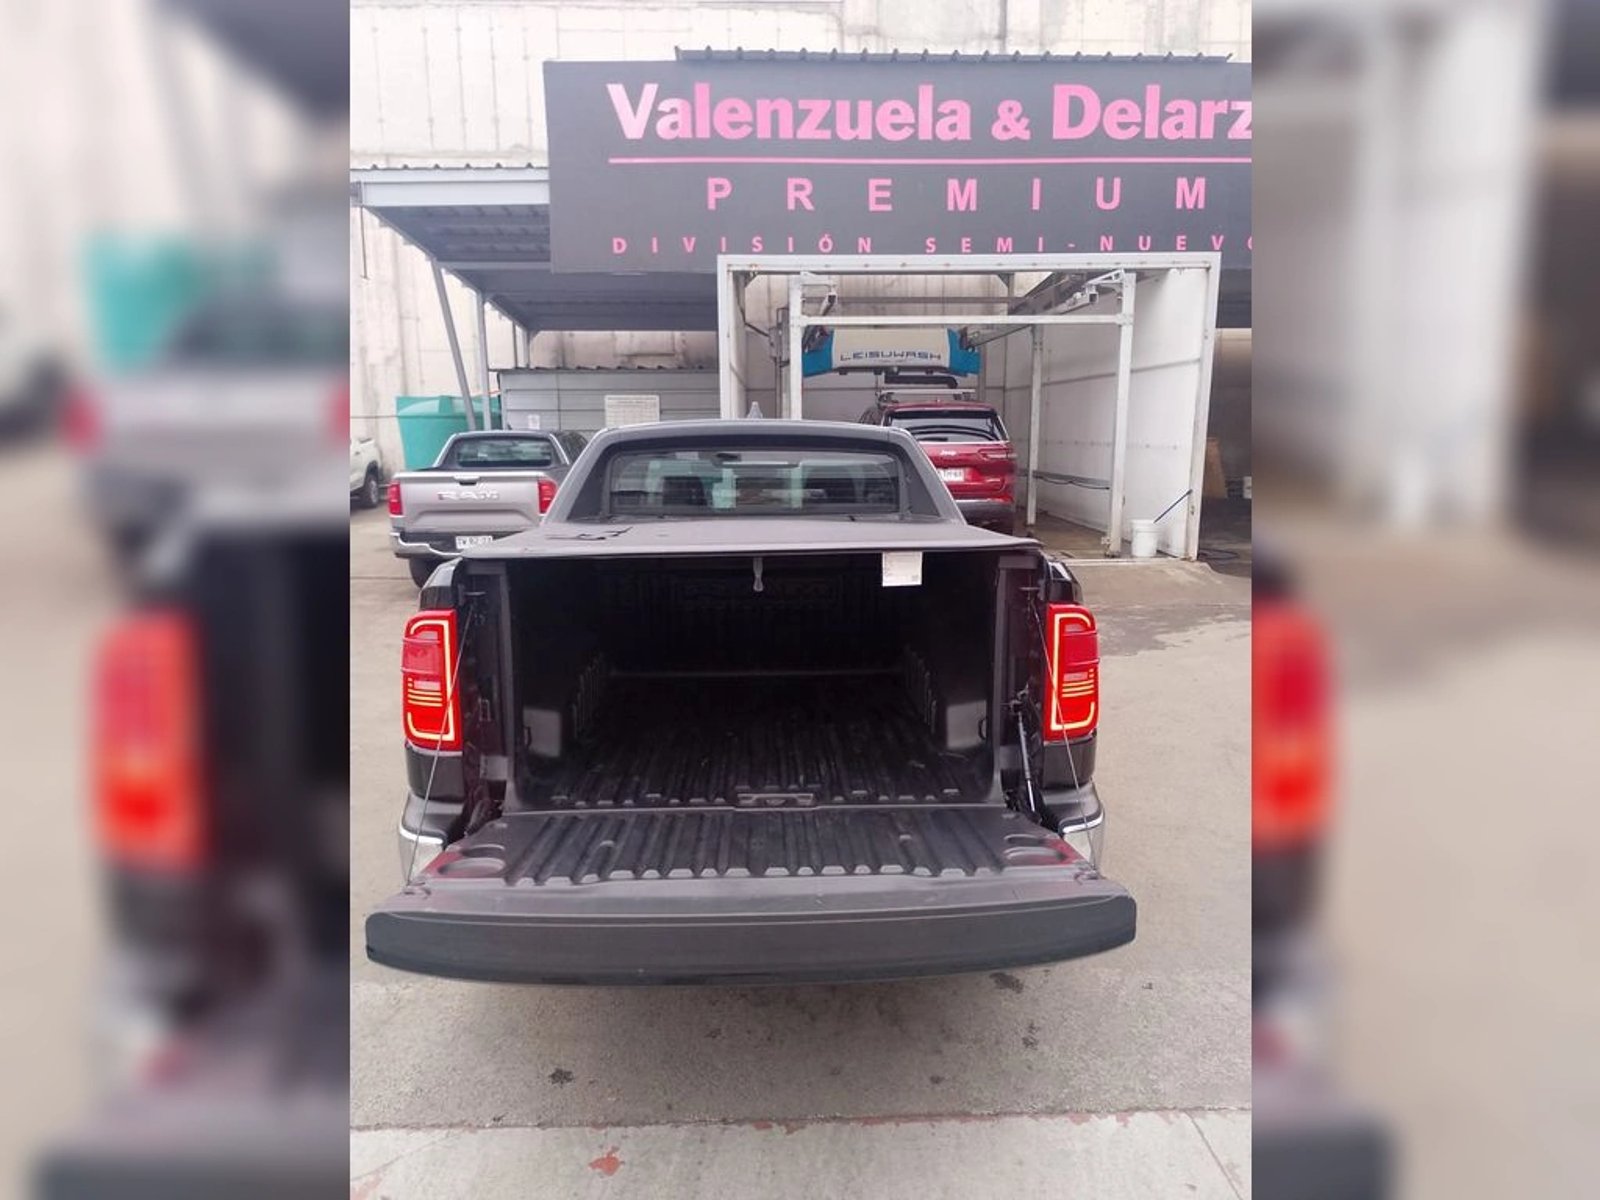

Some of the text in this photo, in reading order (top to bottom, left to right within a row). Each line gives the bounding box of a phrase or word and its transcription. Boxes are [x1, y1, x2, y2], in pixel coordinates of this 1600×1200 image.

[606, 83, 1252, 142] Valenzuela & Delarz
[706, 176, 1207, 213] PREMIUM
[611, 234, 1252, 254] DIVISIÓN SEMI-NUEV
